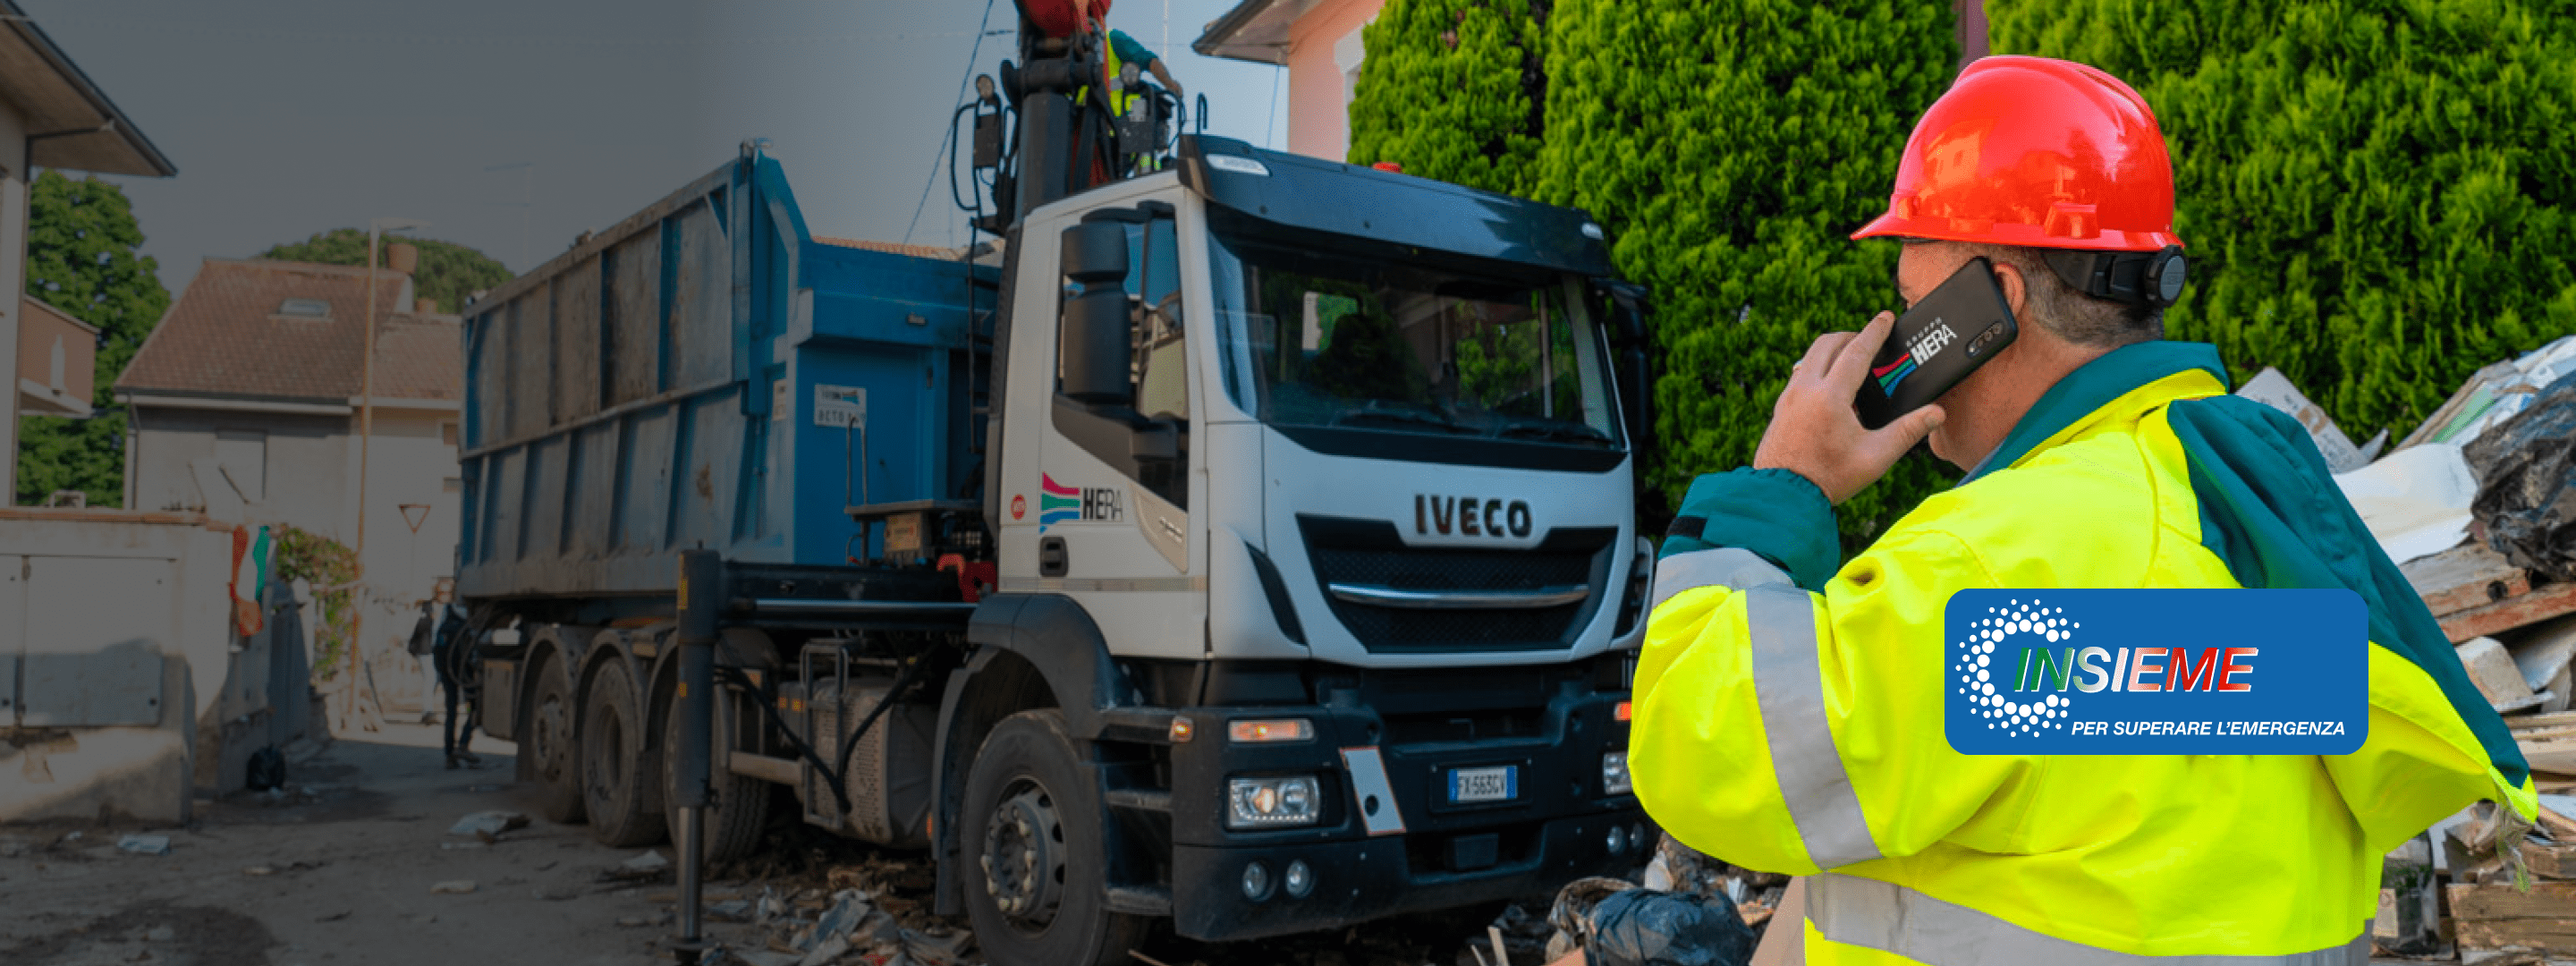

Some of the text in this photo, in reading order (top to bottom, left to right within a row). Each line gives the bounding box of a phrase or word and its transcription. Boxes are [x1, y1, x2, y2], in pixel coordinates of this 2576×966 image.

[1910, 324, 1958, 366] HERA
[1083, 487, 1123, 521] HERA
[1415, 495, 1532, 538] IVECO
